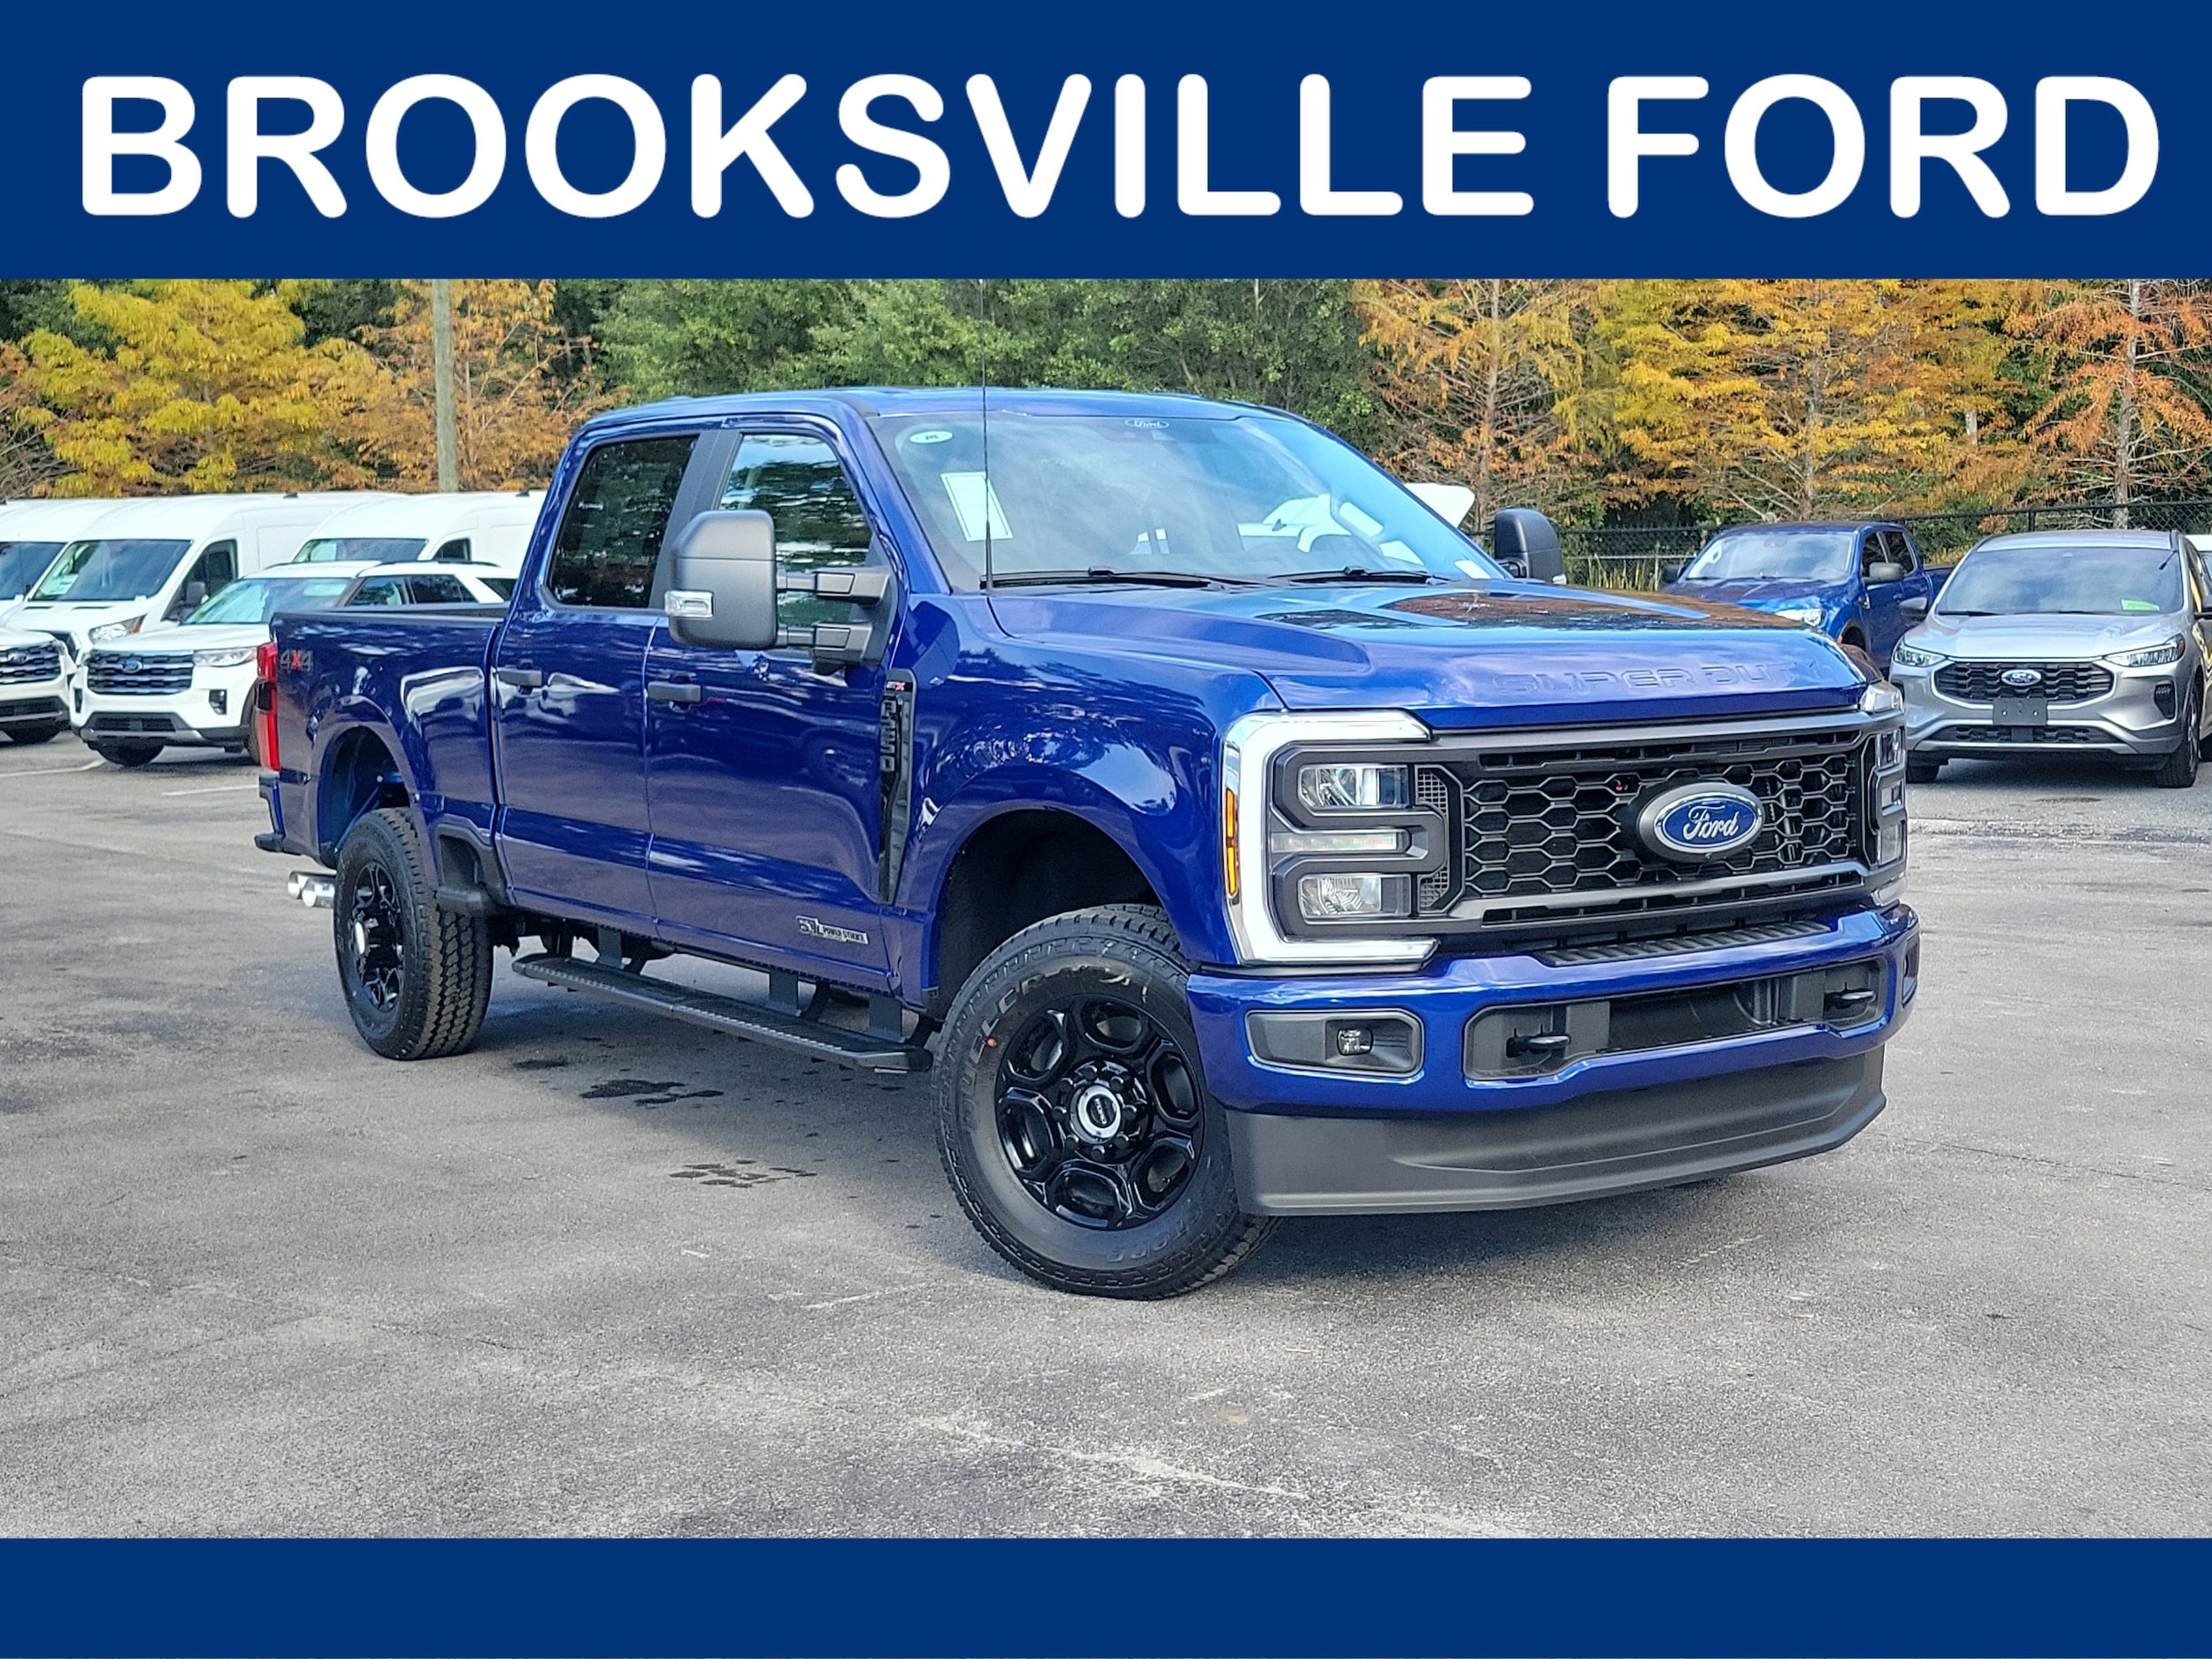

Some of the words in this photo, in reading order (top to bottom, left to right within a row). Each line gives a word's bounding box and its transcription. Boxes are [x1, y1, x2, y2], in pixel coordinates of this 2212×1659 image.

[1493, 668, 1697, 695] SUPER
[1701, 662, 1831, 687] DUTY
[1682, 804, 1740, 841] Ford
